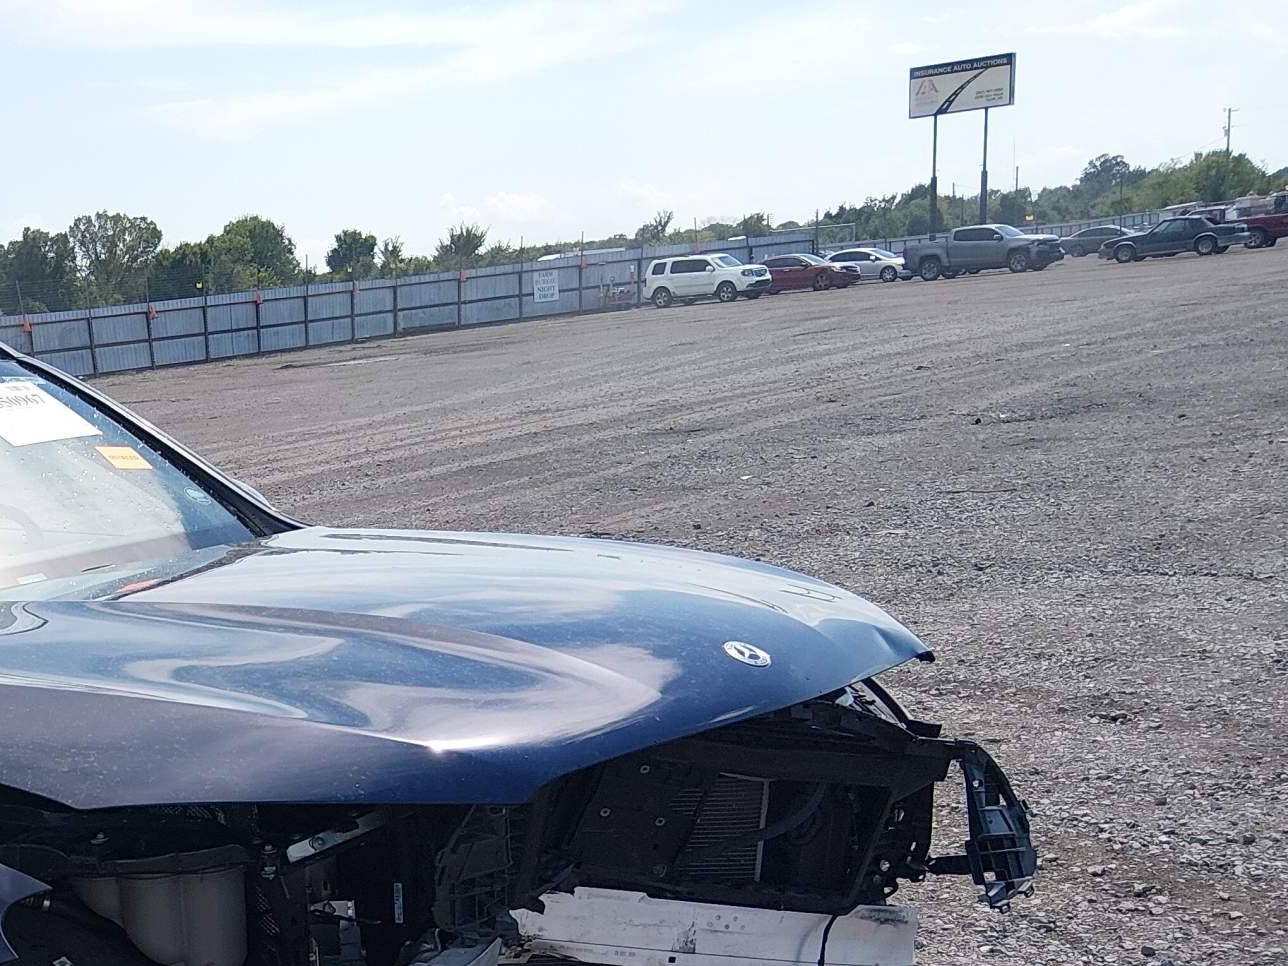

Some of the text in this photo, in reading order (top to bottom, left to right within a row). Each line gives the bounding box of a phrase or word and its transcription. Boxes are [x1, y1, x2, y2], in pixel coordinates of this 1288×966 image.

[913, 57, 1007, 78] INSURANCE AUTO AUCTIONS
[537, 285, 555, 293] NIGHT
